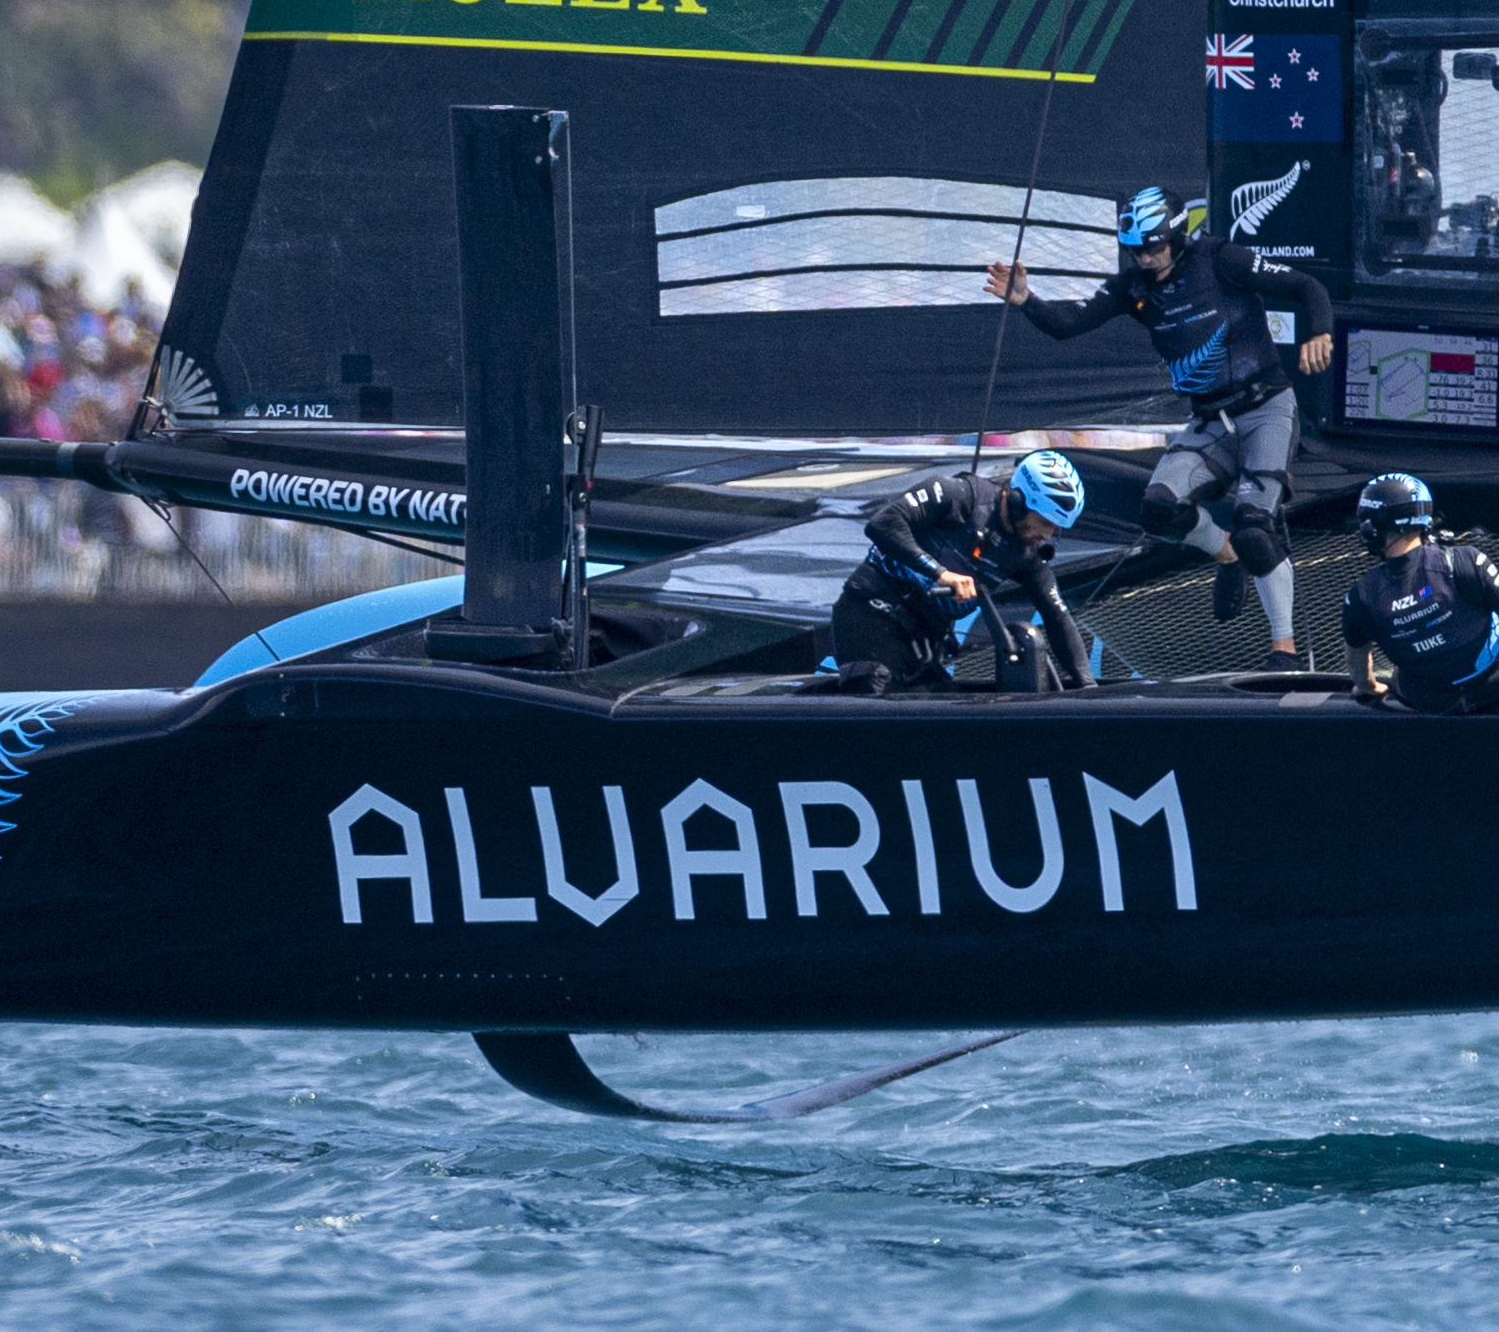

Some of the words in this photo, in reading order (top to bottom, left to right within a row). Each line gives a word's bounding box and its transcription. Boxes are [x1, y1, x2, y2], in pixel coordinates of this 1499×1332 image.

[265, 403, 300, 418] AP-1
[304, 404, 333, 419] NZL
[230, 468, 364, 513] POWERED
[368, 485, 407, 518] BY
[408, 489, 467, 525] NAT
[1391, 594, 1419, 612] NZL
[1393, 602, 1440, 626] ALVARIUM
[1412, 633, 1447, 653] TUKE
[328, 768, 1199, 928] ALVARIUM
